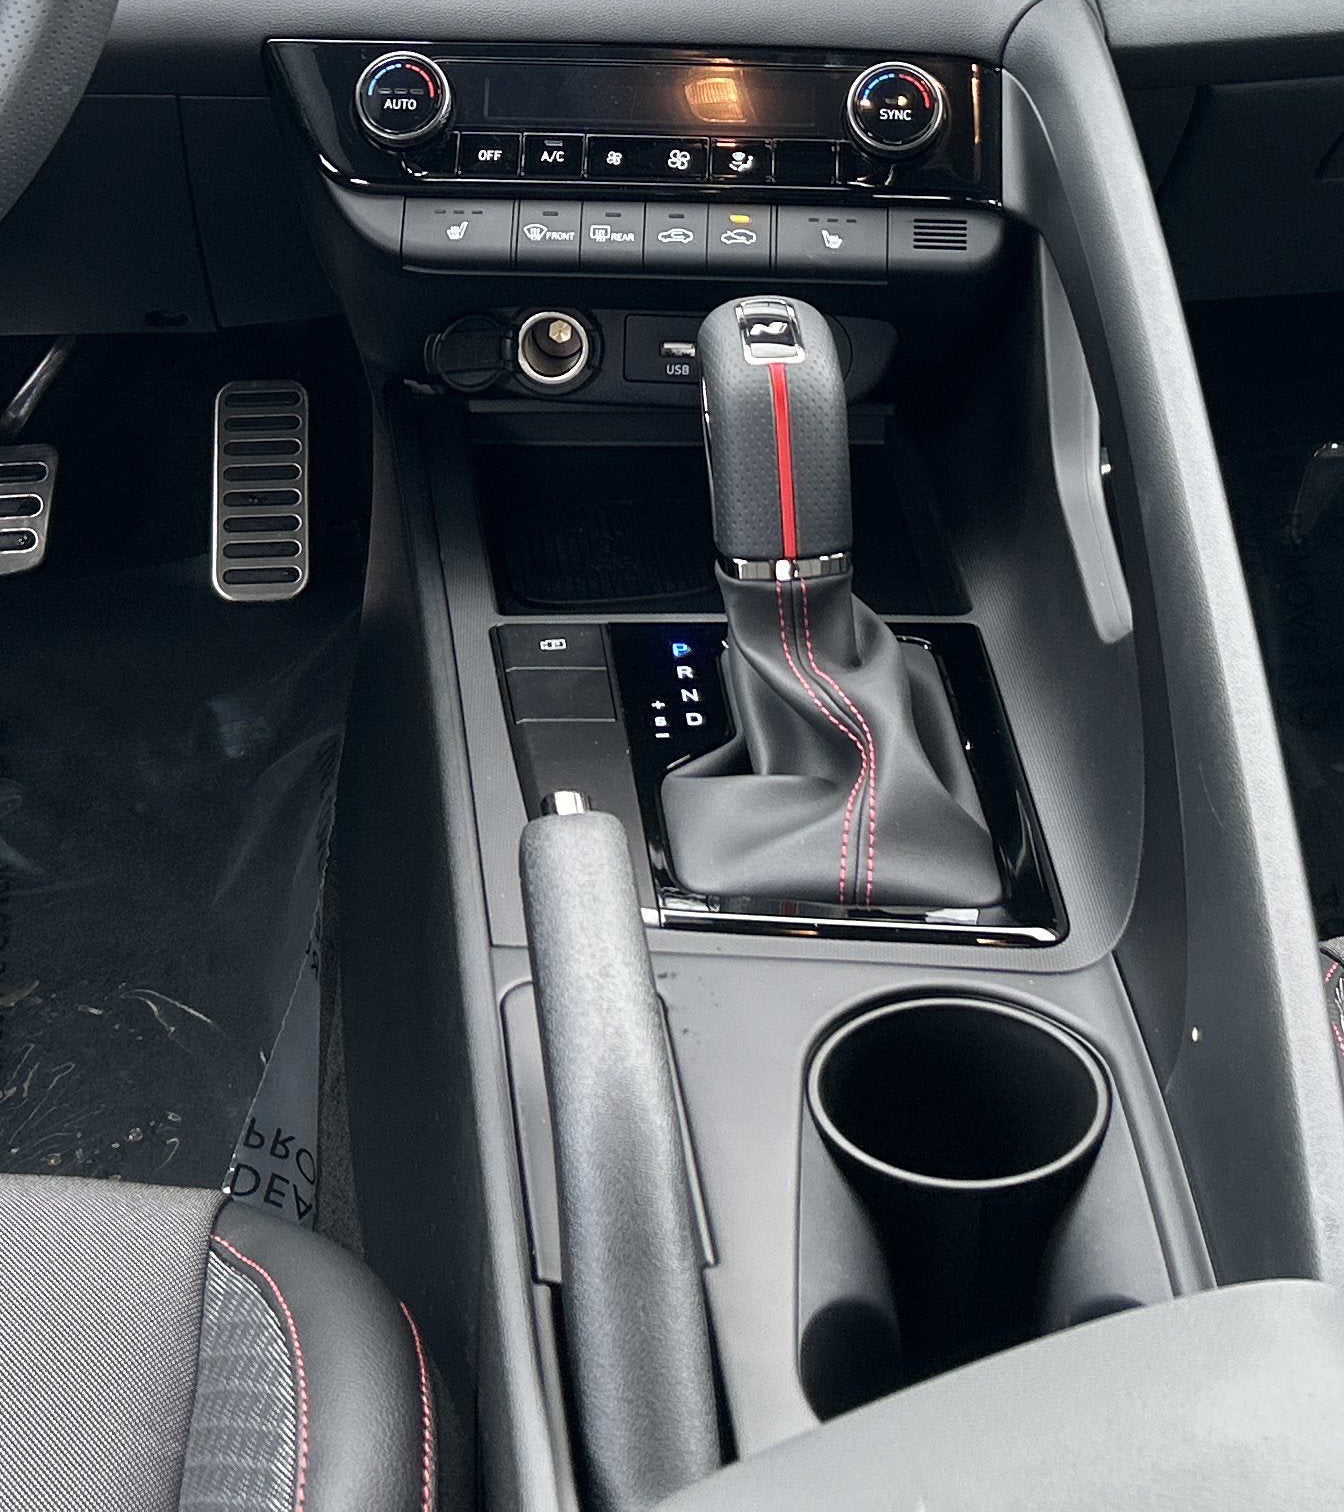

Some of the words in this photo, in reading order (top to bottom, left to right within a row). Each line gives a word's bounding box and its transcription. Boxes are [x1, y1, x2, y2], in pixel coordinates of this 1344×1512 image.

[383, 98, 417, 111] AUTO
[879, 108, 912, 122] SYNC
[477, 149, 502, 162] OFF
[540, 149, 565, 163] A/C
[545, 231, 575, 242] FRONT
[610, 232, 635, 242] REAR
[666, 363, 690, 376] USB
[672, 642, 691, 657] P
[676, 665, 693, 679] R
[681, 688, 699, 702] N
[655, 715, 667, 727] S
[686, 712, 703, 727] D
